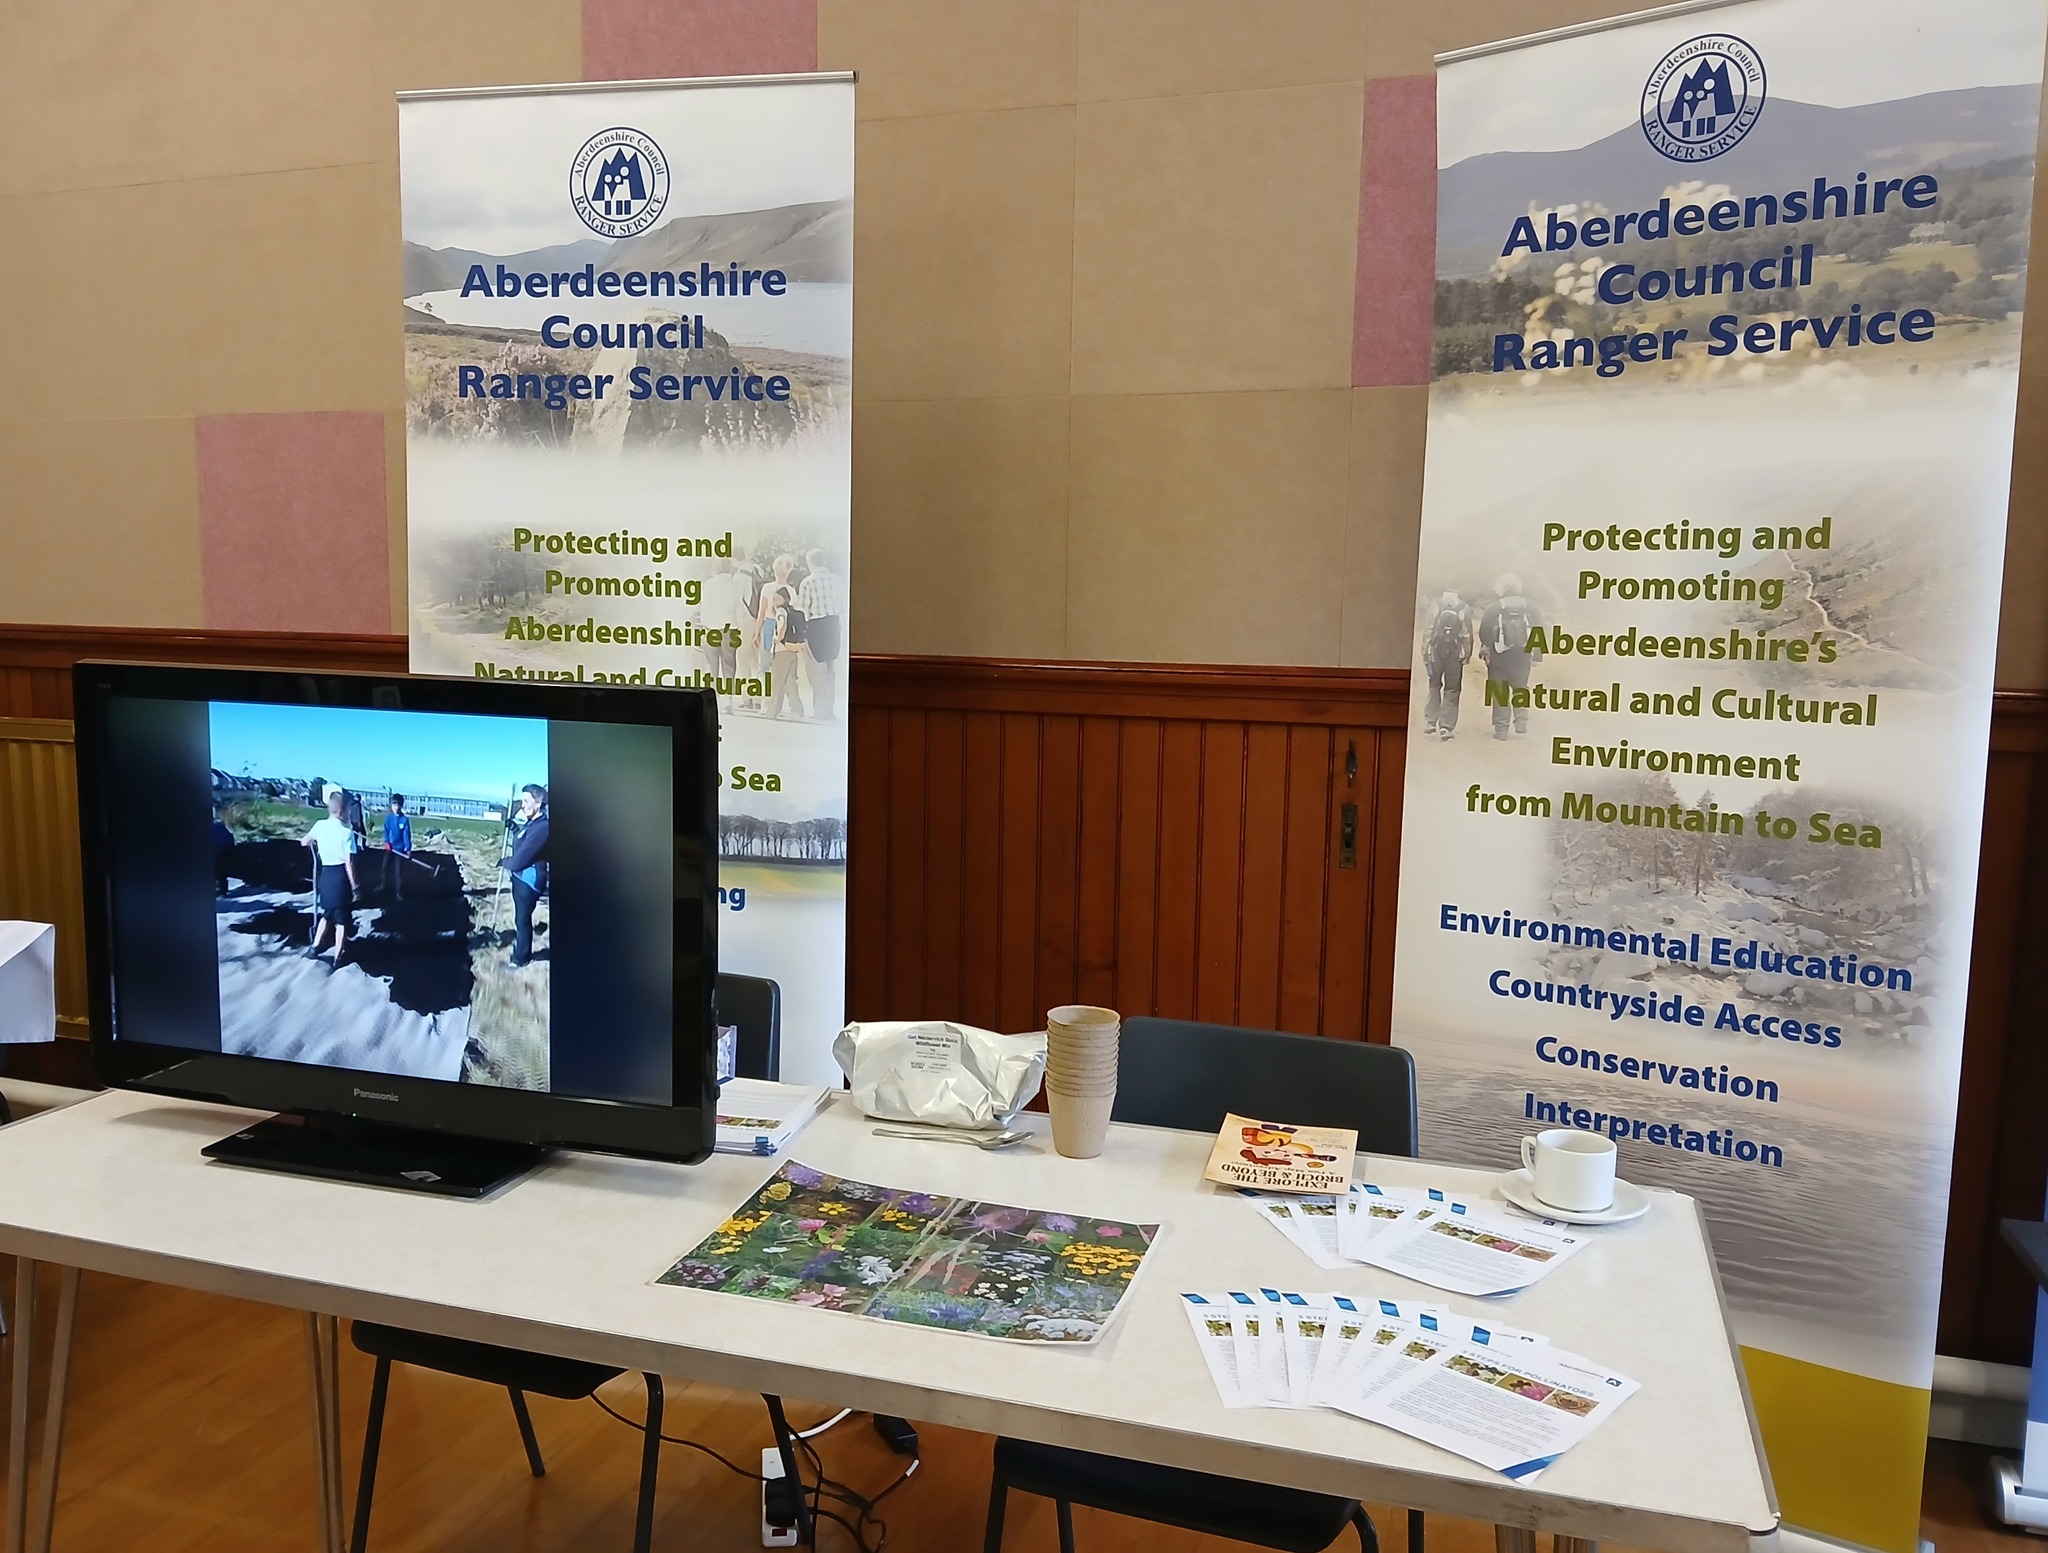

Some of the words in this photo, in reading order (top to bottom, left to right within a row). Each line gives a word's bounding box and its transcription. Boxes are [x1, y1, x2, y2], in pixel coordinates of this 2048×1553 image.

[1648, 39, 1724, 99] Aberdeenshire
[1727, 42, 1760, 82] Council
[1647, 119, 1695, 159] RANGER
[1700, 105, 1757, 158] SERVICE
[575, 131, 635, 177] Aberdeenshire
[638, 138, 665, 175] Council
[575, 195, 616, 235] RANGER
[619, 194, 663, 235] SERVICE
[1502, 172, 1939, 257] Aberdeenshire
[460, 262, 787, 298] Aberdeenshire
[1598, 243, 1814, 305] Council
[541, 315, 704, 349] Council
[1493, 327, 1688, 378] Ranger
[1707, 303, 1936, 357] Service
[458, 365, 613, 410] Ranger
[629, 368, 790, 401] Service
[513, 528, 669, 562] Protecting
[677, 532, 732, 558] and
[1542, 519, 1741, 559] Protecting
[1751, 517, 1831, 550] and
[545, 570, 702, 604] Promoting
[1578, 570, 1785, 610] Promoting
[505, 617, 742, 648] Aberdeenshire’s
[1524, 627, 1838, 665] Aberdeenshire’s
[474, 662, 584, 682] Natural
[593, 667, 646, 685] and
[655, 669, 772, 697] Cultural
[1483, 680, 1620, 713] Natural
[1629, 687, 1701, 717] and
[1711, 689, 1877, 727] Cultural
[730, 766, 781, 792] Sea
[1551, 737, 1801, 782] Environment
[1465, 784, 1551, 817] from
[1562, 792, 1744, 836] Mountain
[1756, 810, 1797, 840] to
[1808, 813, 1883, 849] Sea
[1440, 904, 1699, 964] Environmental
[1711, 937, 1913, 992] Education
[1489, 970, 1705, 1026] Countryside
[1714, 1003, 1842, 1048] Access
[1536, 1036, 1779, 1102] Conservation
[353, 1087, 399, 1102] Panasonic
[1525, 1093, 1784, 1168] Interpretation
[1221, 1164, 1277, 1178] BEYOND
[1232, 1173, 1259, 1183] THE
[1263, 1177, 1328, 1189] EXPLORE
[1282, 1171, 1292, 1179] &
[1297, 1173, 1344, 1183] BROCH
[1469, 1352, 1500, 1367] STEPS
[1501, 1363, 1522, 1374] FOR
[1524, 1371, 1595, 1398] POLLINATORS
